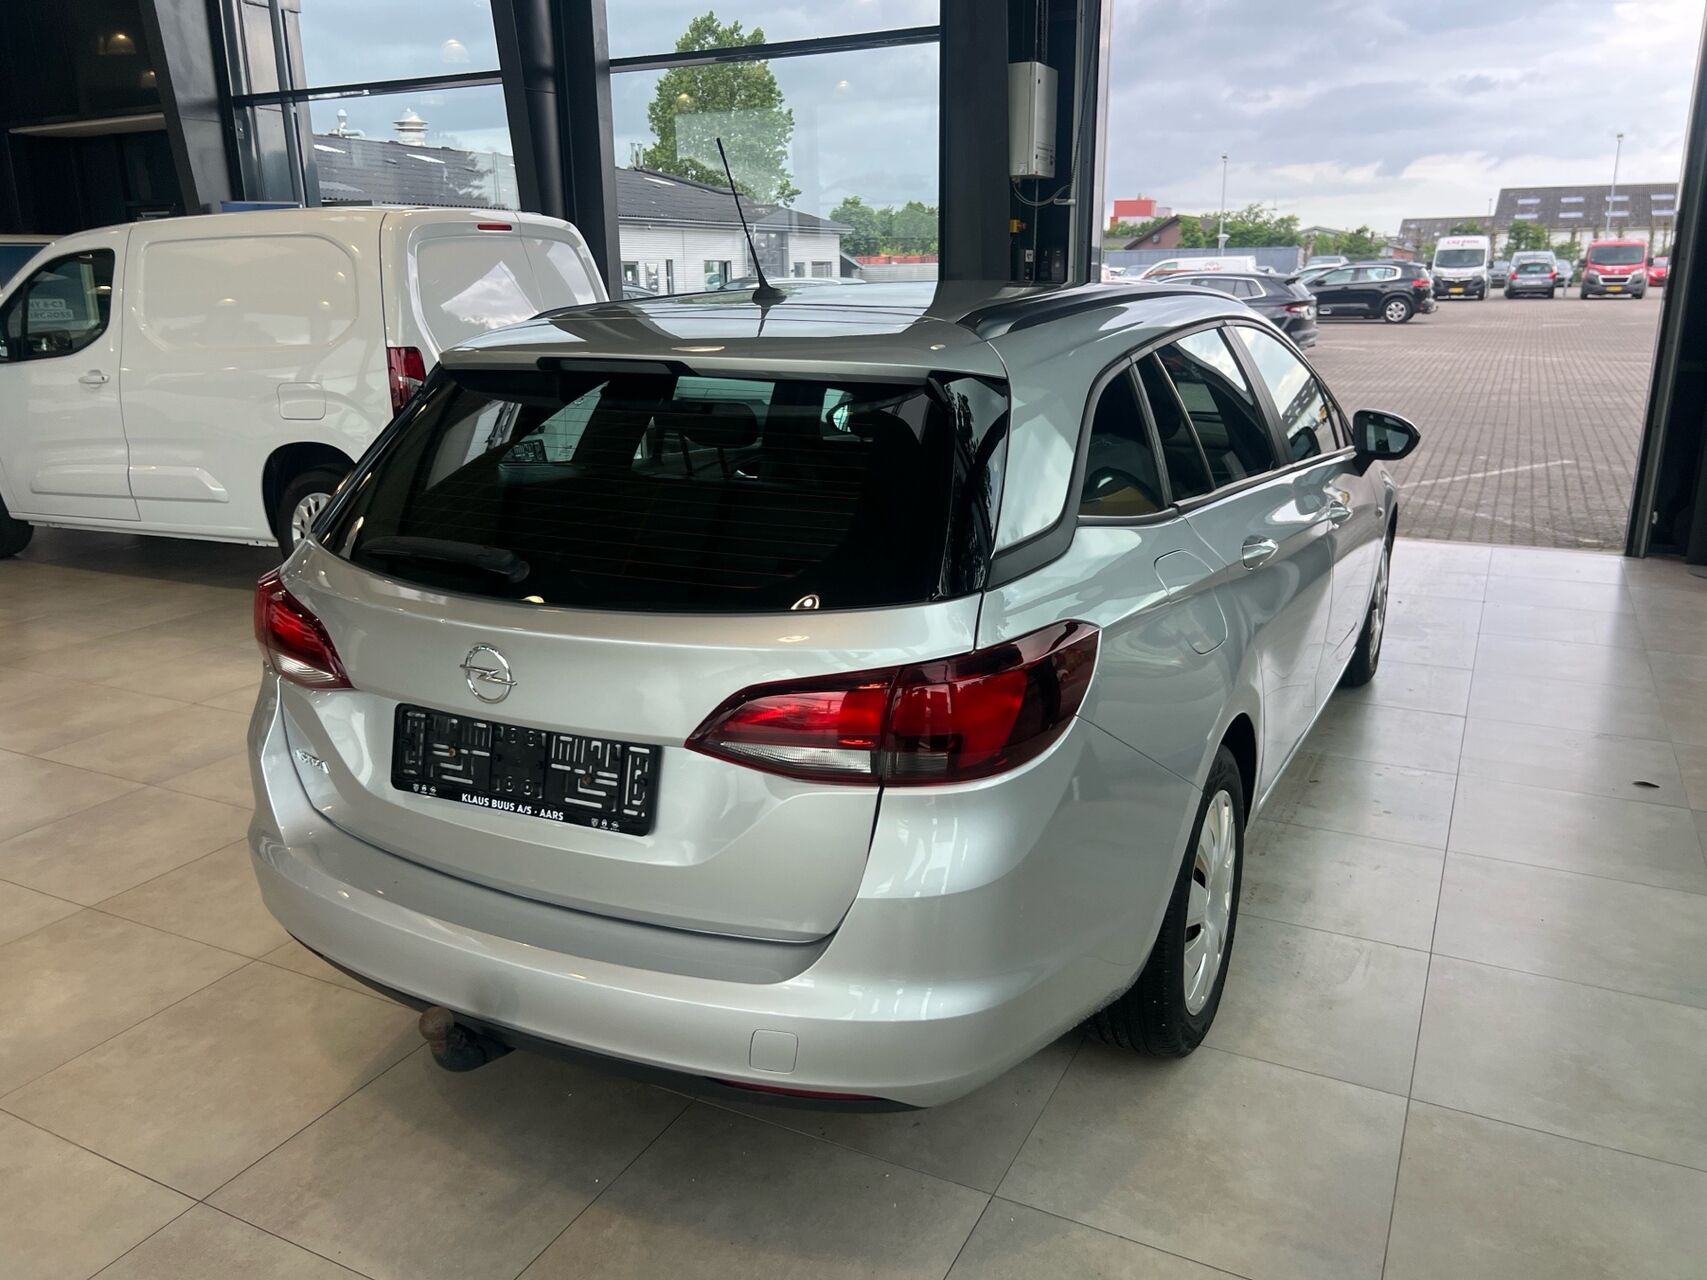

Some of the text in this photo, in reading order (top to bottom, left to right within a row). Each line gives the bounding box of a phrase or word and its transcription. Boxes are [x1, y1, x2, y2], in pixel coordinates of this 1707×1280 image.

[461, 793, 564, 821] KLAUS BUUS A/S AARS
